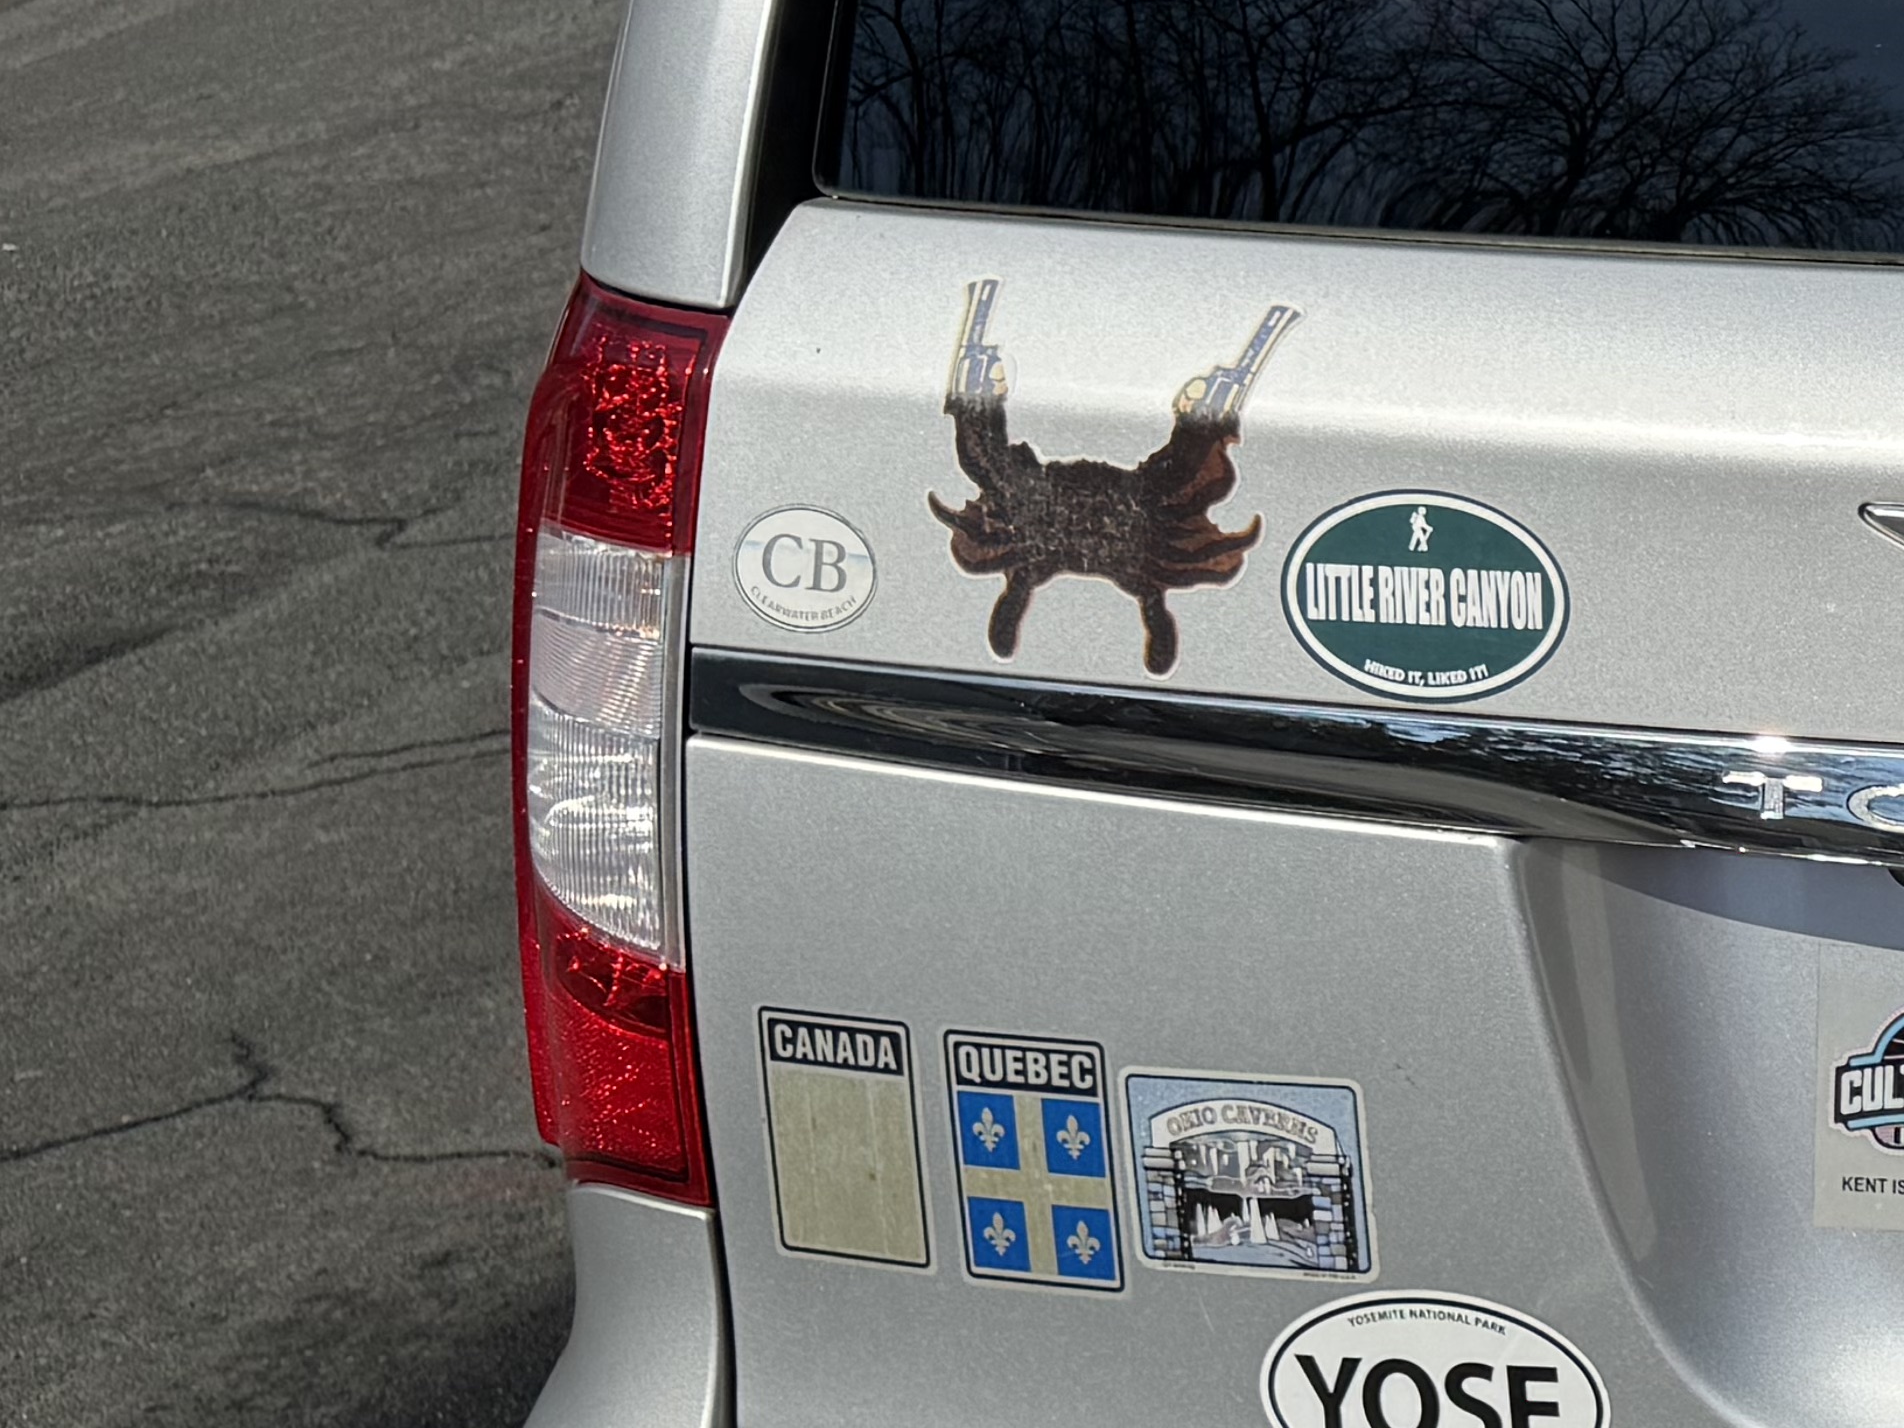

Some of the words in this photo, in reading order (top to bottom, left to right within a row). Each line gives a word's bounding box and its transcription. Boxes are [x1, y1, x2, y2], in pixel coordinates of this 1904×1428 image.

[761, 533, 848, 594] CB
[749, 584, 819, 622] CLEARWATER
[820, 595, 858, 622] BEACH
[1304, 561, 1377, 623] LITTLE
[1377, 564, 1447, 627] RIVER
[1449, 566, 1544, 631] CANYON
[1363, 658, 1407, 683] HIKED
[1428, 668, 1467, 686] LIKED
[773, 1023, 899, 1071] CANADA
[957, 1044, 1095, 1089] QUEBEC
[1165, 1105, 1218, 1137] OHIO
[1220, 1103, 1319, 1145] CAVERNS
[1840, 1176, 1888, 1194] KENT
[1346, 1308, 1406, 1328] YOSEMITE
[1408, 1308, 1472, 1325] NATIONAL
[1474, 1316, 1507, 1336] PARK
